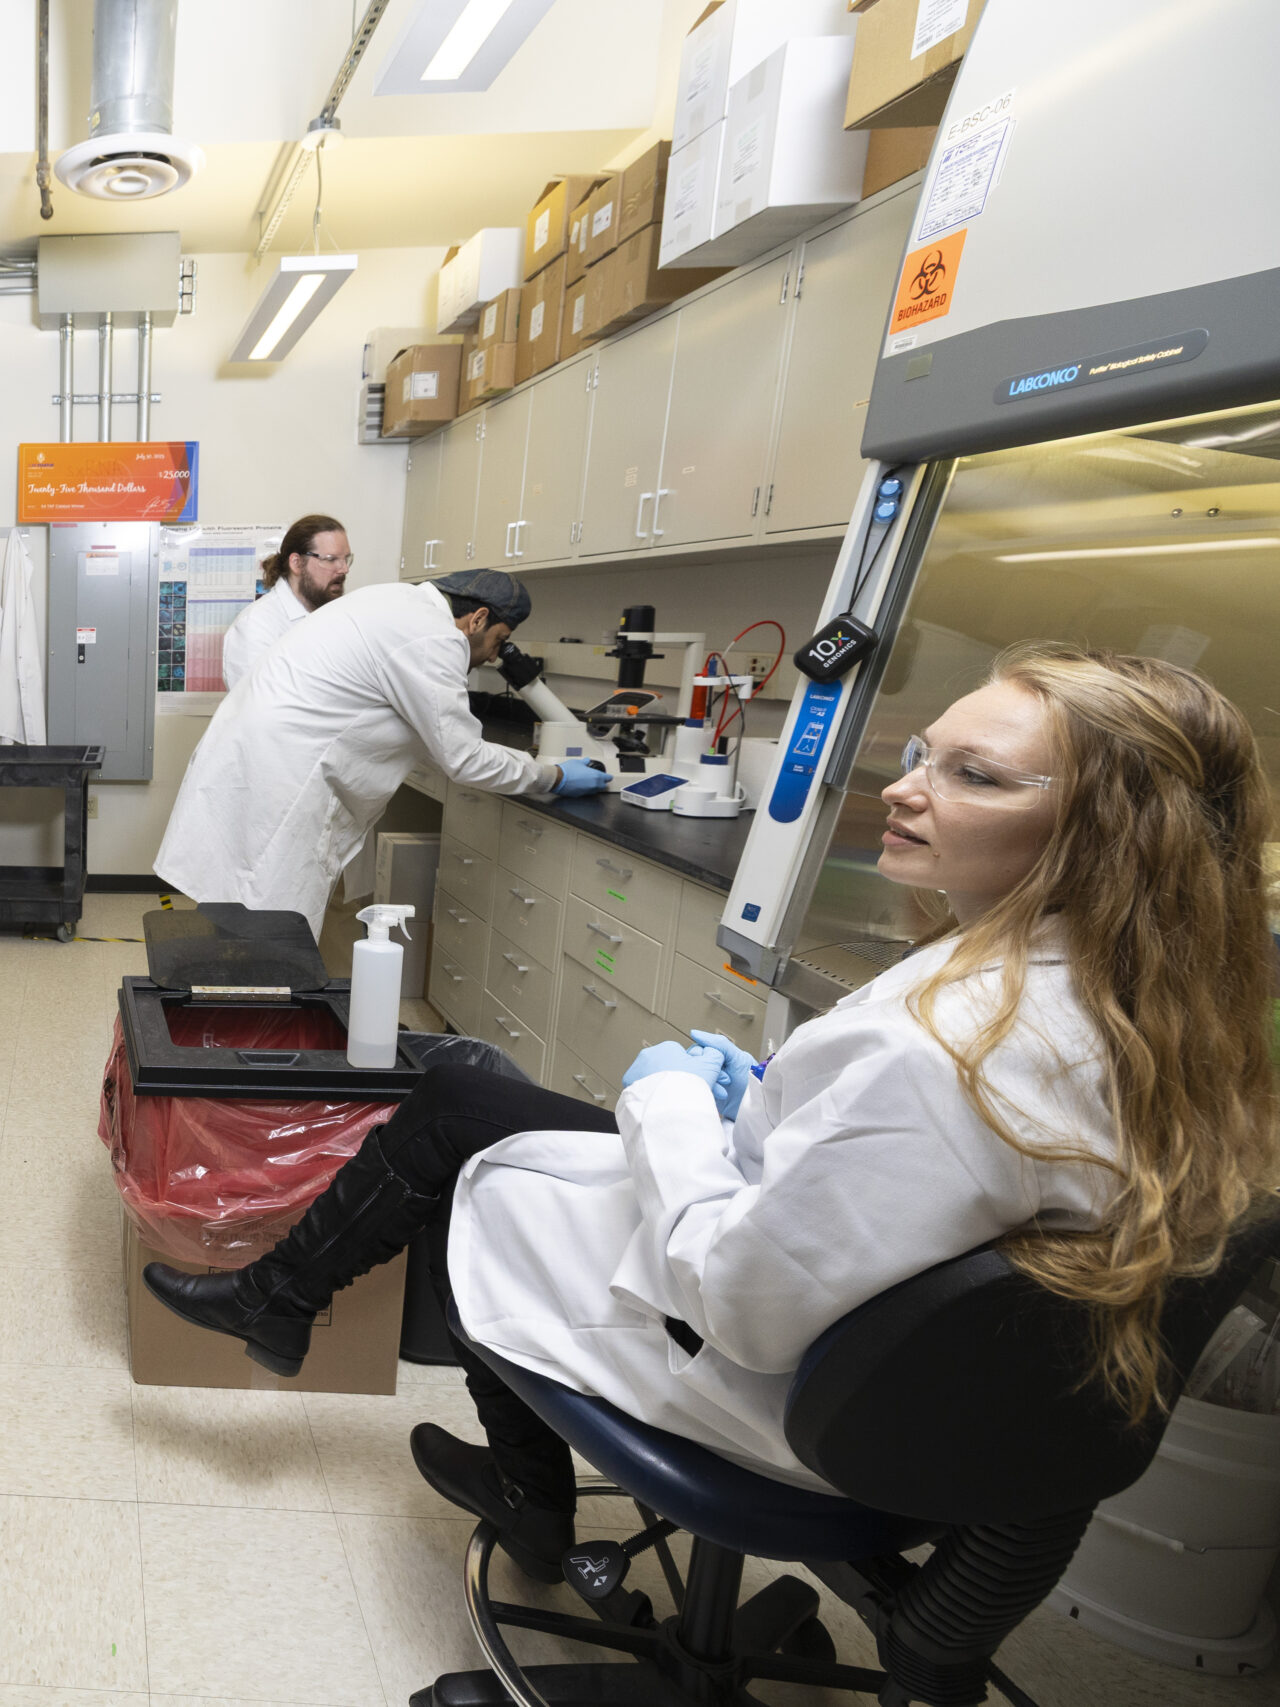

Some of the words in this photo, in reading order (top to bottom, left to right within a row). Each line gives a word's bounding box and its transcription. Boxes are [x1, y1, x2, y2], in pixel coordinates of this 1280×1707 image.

[947, 93, 1012, 141] E-BSC-06
[897, 293, 947, 322] BIOHAZARD
[1008, 366, 1079, 396] LABCONCO
[1156, 346, 1184, 360] Cabinet
[28, 483, 76, 497] Twenty-Five
[77, 480, 116, 493] Thousand
[117, 481, 147, 493] Dollars
[822, 639, 857, 669] GENOMICS
